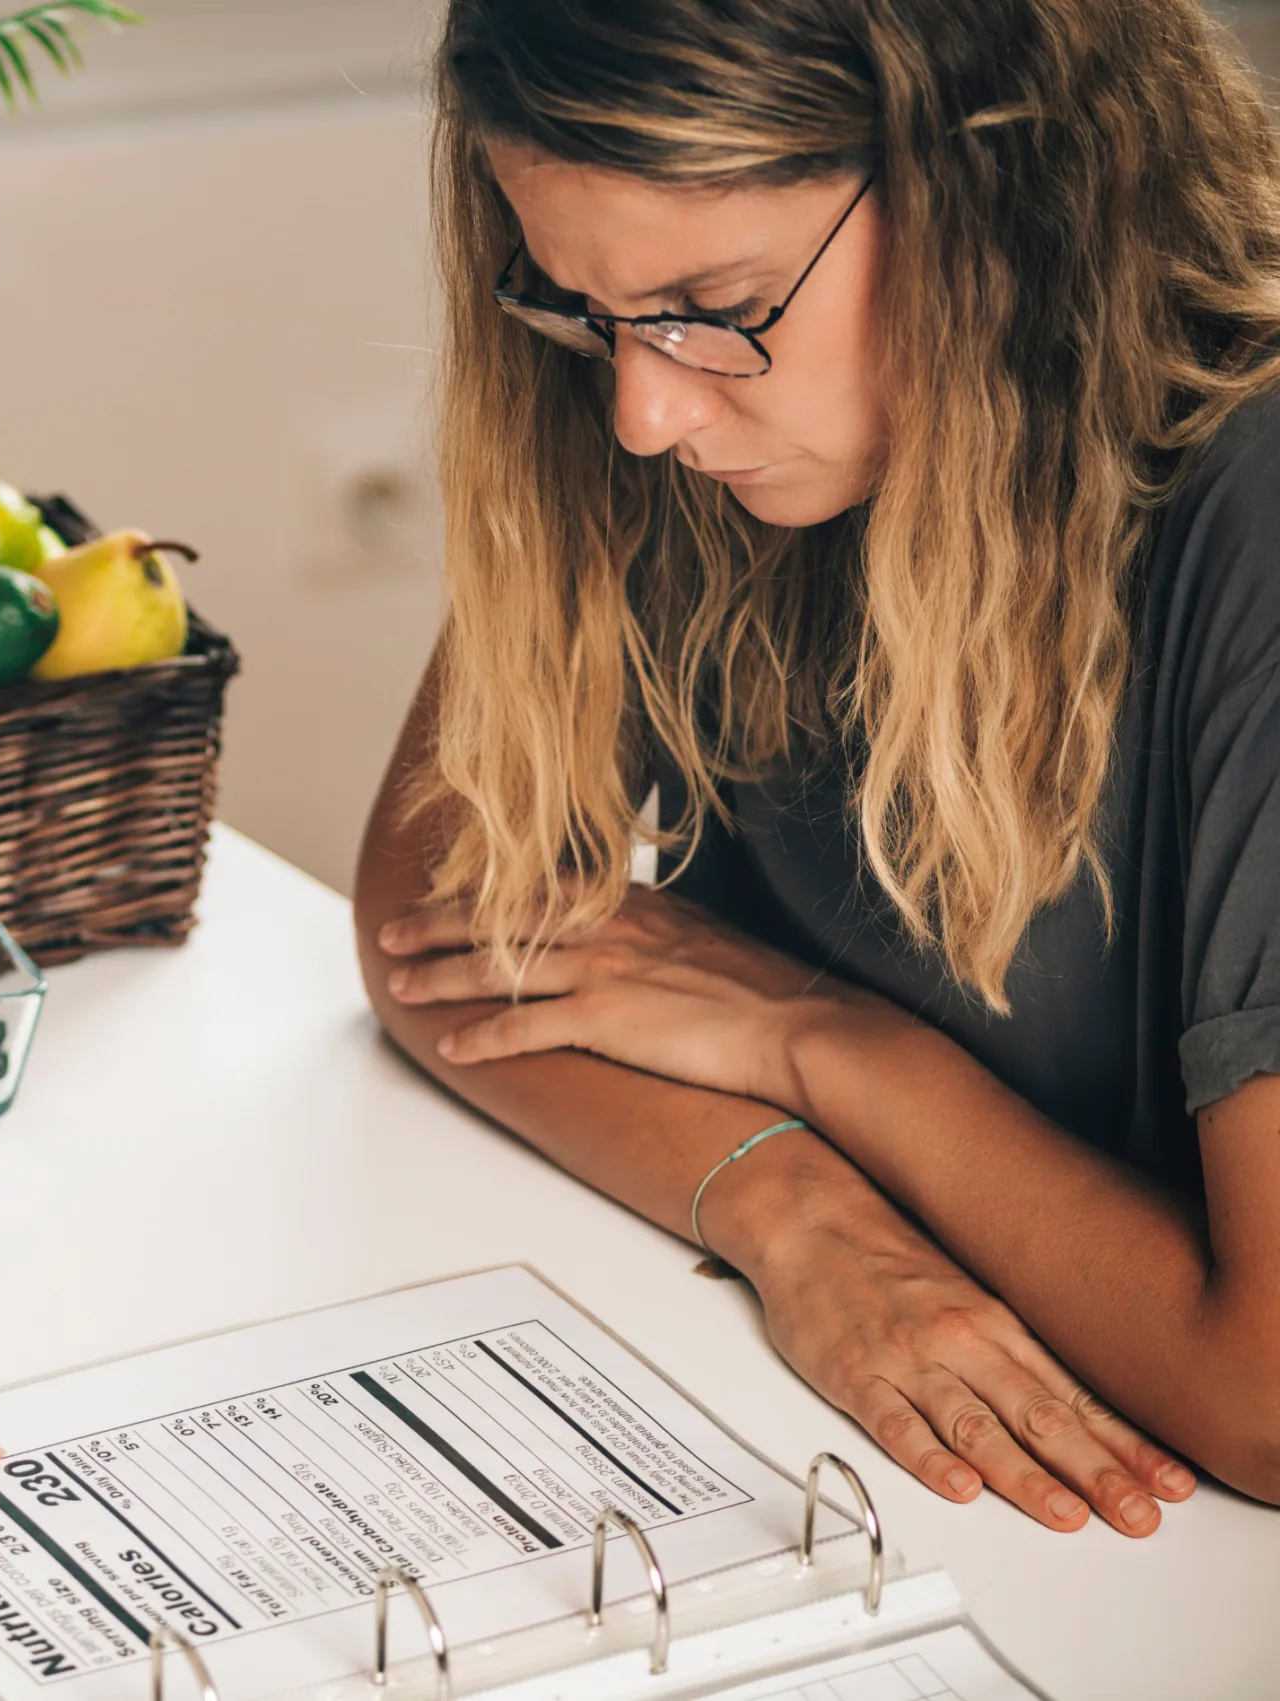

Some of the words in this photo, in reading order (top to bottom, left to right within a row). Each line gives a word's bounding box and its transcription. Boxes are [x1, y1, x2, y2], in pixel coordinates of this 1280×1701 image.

[458, 1343, 478, 1360] 6%
[495, 1337, 509, 1347] in
[506, 1331, 540, 1357] calories
[431, 1350, 456, 1371] 45%
[501, 1344, 536, 1370] nutrient
[378, 1365, 403, 1385] 10%
[405, 1357, 432, 1379] 20%
[530, 1367, 543, 1375] a
[537, 1373, 563, 1393] much
[310, 1383, 340, 1407] 20%
[559, 1392, 580, 1409] how
[571, 1387, 596, 1405] daily
[227, 1404, 254, 1428] 13%
[255, 1397, 283, 1421] 14%
[575, 1405, 598, 1421] you
[590, 1402, 602, 1410] a
[597, 1408, 611, 1418] to
[602, 1396, 638, 1425] nutrition
[173, 1418, 196, 1437] 0%
[201, 1411, 222, 1430] 7%
[589, 1419, 611, 1436] tells
[117, 1432, 141, 1452] 5%
[353, 1422, 395, 1454] Sugars
[605, 1416, 651, 1454] contributes
[605, 1433, 632, 1451] (DV)
[630, 1423, 669, 1451] general
[89, 1440, 118, 1463] 10%
[574, 1444, 617, 1477] 235mg
[624, 1450, 651, 1472] Value
[644, 1452, 669, 1470] food
[660, 1449, 679, 1461] for
[291, 1462, 317, 1482] 37g
[385, 1451, 427, 1481] Added
[661, 1467, 678, 1476] of
[670, 1458, 698, 1477] used
[3, 1458, 82, 1507] 230
[94, 1476, 125, 1500] Daily
[502, 1473, 539, 1501] 2mcg
[531, 1468, 581, 1500] 260mg
[647, 1469, 673, 1488] Daily
[672, 1474, 706, 1498] serving
[699, 1480, 721, 1494] day
[362, 1493, 381, 1507] 4g
[383, 1481, 408, 1501] 12g
[419, 1480, 446, 1501] 10g
[610, 1476, 668, 1521] Potassium
[669, 1485, 679, 1494] %
[676, 1493, 695, 1507] The
[701, 1495, 713, 1503] a
[715, 1491, 729, 1499] a
[121, 1498, 132, 1510] %
[475, 1500, 496, 1515] 3g
[529, 1499, 549, 1511] D
[280, 1512, 309, 1536] 0mg
[314, 1483, 394, 1553] Carbohydrate
[375, 1508, 409, 1533] Fiber
[404, 1501, 445, 1535] Sugars
[441, 1500, 489, 1538] Includes
[542, 1508, 585, 1543] Vitamin
[220, 1525, 239, 1539] 1g
[317, 1517, 356, 1550] 160mg
[492, 1514, 541, 1554] Protein
[231, 1539, 256, 1557] Fat
[267, 1535, 288, 1551] 0g
[403, 1532, 445, 1564] Dietary
[437, 1532, 469, 1556] Total
[73, 1540, 121, 1582] serving
[215, 1554, 237, 1571] 8g
[278, 1549, 305, 1568] Fat
[299, 1535, 376, 1596] Cholesterol
[388, 1553, 426, 1584] Total
[229, 1569, 258, 1589] Fat
[249, 1555, 305, 1599] Saturated
[299, 1566, 331, 1593] Trans
[352, 1549, 401, 1590] Sdium
[23, 1588, 57, 1609] per
[47, 1578, 82, 1606] size
[117, 1583, 145, 1602] per
[118, 1550, 219, 1636] Calories
[248, 1588, 288, 1619] Total
[45, 1608, 103, 1655] servings
[77, 1607, 137, 1659] Serving
